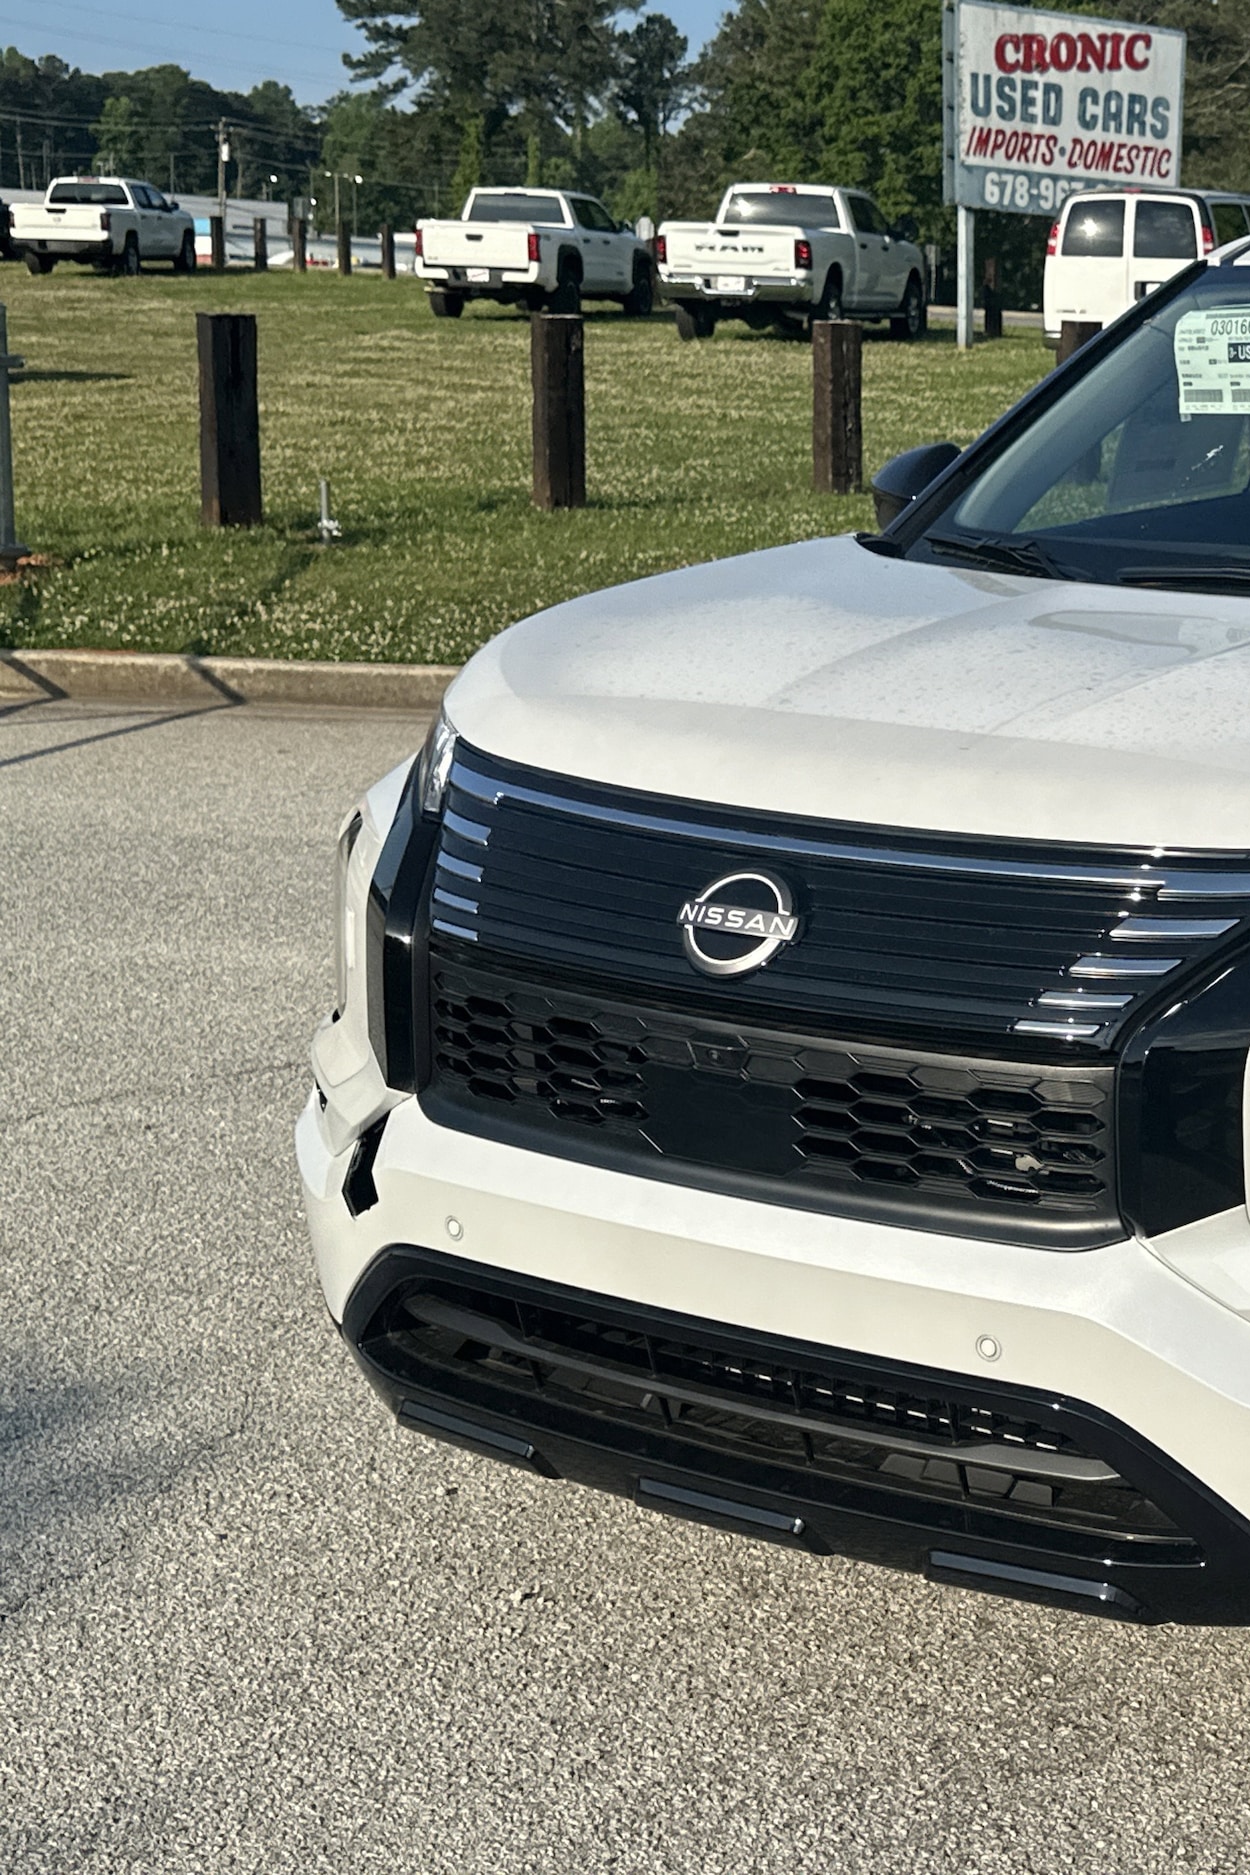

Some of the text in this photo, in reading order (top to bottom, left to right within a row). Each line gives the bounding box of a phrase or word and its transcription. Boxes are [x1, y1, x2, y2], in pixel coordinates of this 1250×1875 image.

[994, 32, 1152, 74] CRONIC
[970, 72, 1170, 140] USED CARS
[679, 903, 795, 936] NISSAN
